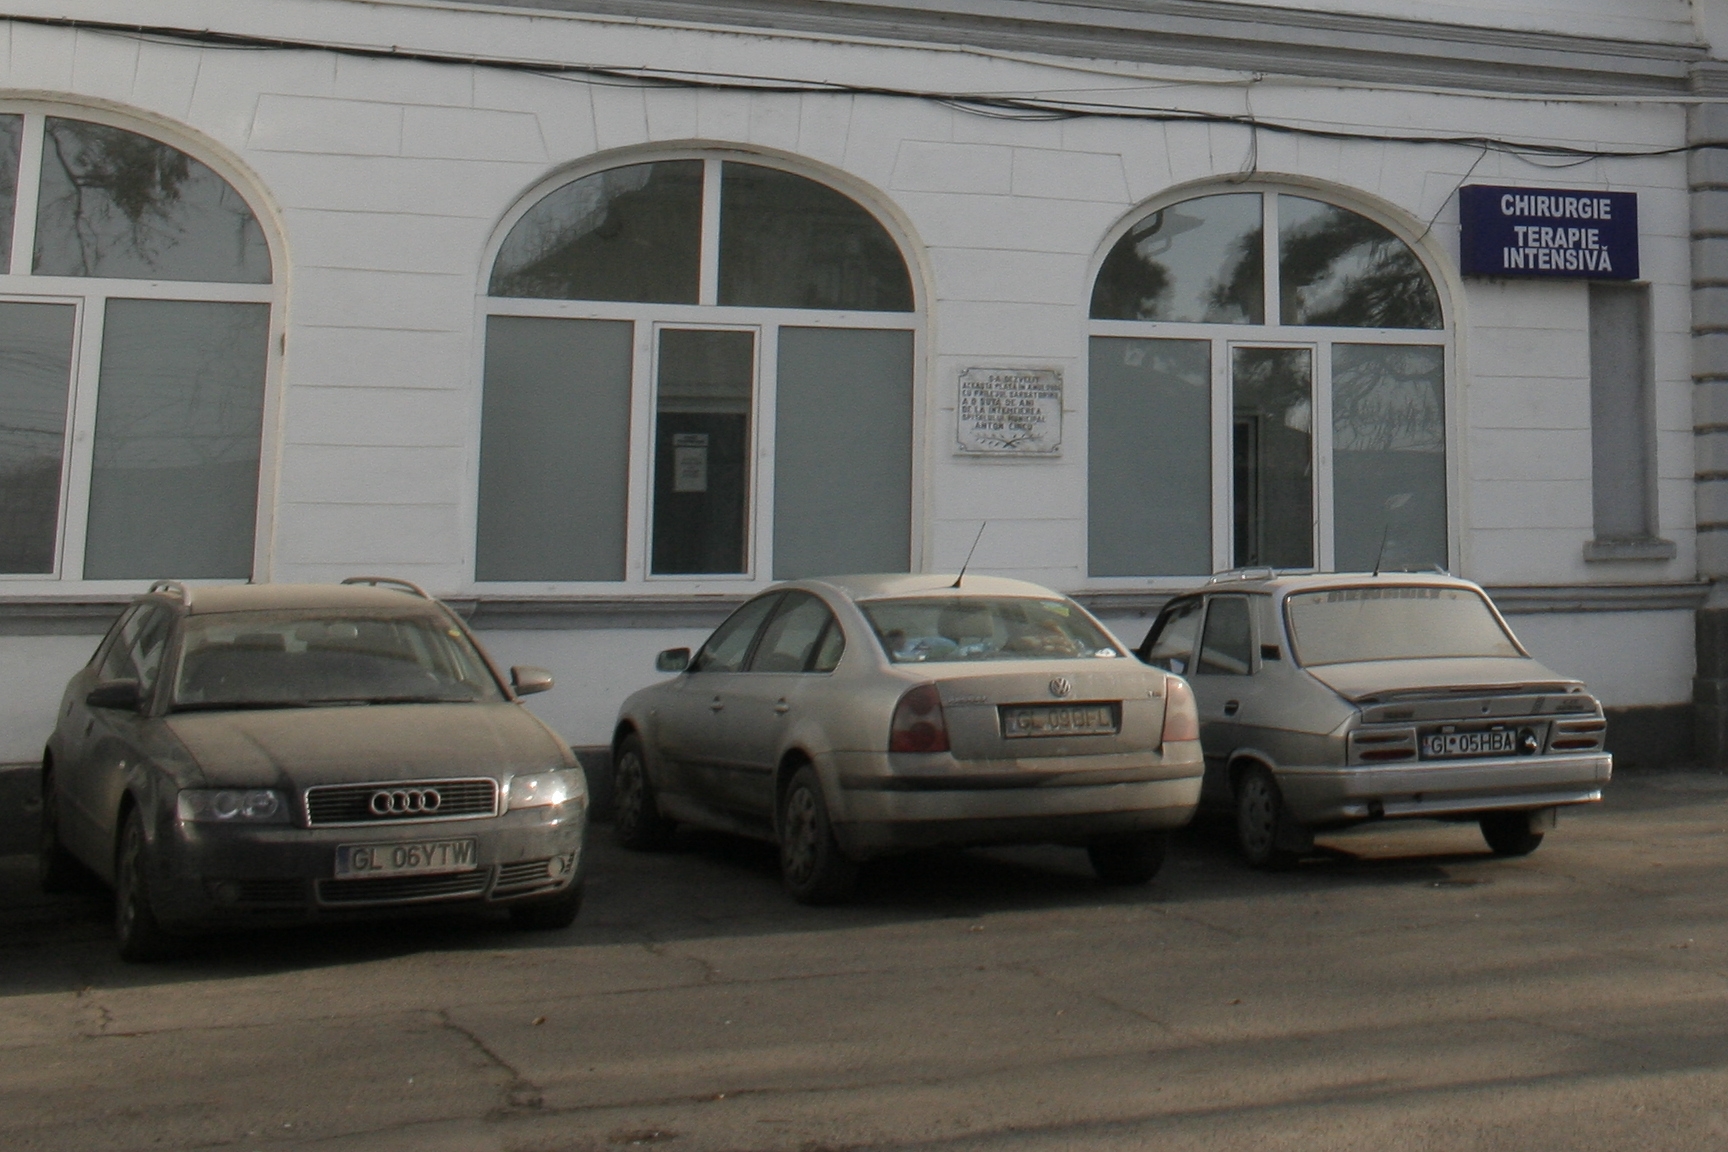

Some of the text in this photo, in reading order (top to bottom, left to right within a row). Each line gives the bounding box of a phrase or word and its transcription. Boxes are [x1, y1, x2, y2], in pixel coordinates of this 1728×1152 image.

[1501, 194, 1612, 220] CHIRURGIE
[1514, 226, 1600, 249] TERAPIE
[1503, 246, 1613, 272] INTENSIVĂ
[1431, 735, 1450, 754] GL
[353, 840, 470, 871] GL 06YTW
